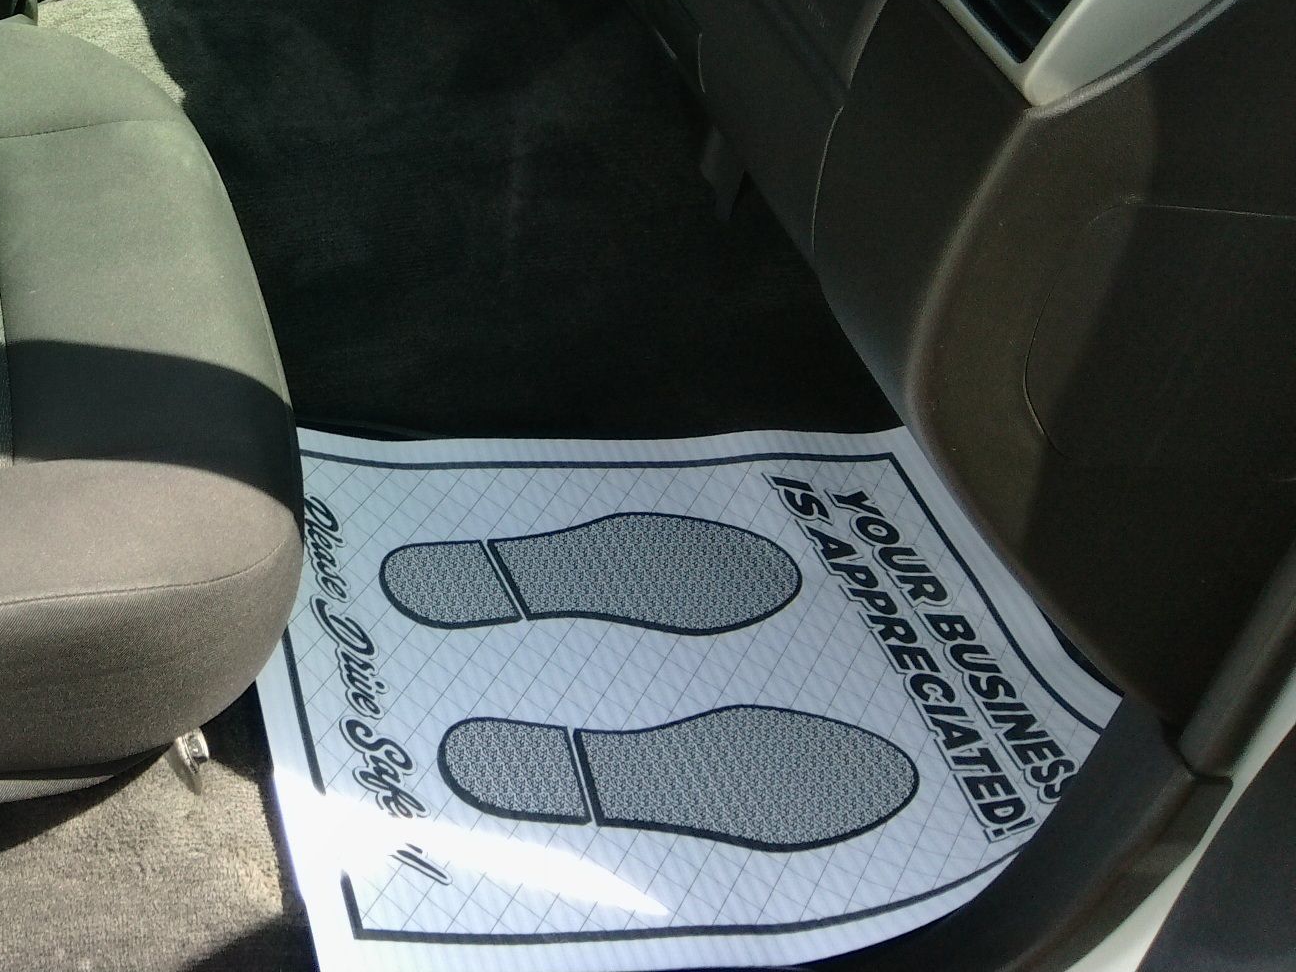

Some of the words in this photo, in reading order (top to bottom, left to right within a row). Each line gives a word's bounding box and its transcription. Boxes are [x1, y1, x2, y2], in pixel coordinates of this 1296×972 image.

[305, 494, 349, 602] Please
[828, 489, 950, 607] YOUR
[311, 595, 388, 720] Drive
[767, 475, 832, 521] IS
[802, 524, 1037, 840] APPRECIATED!
